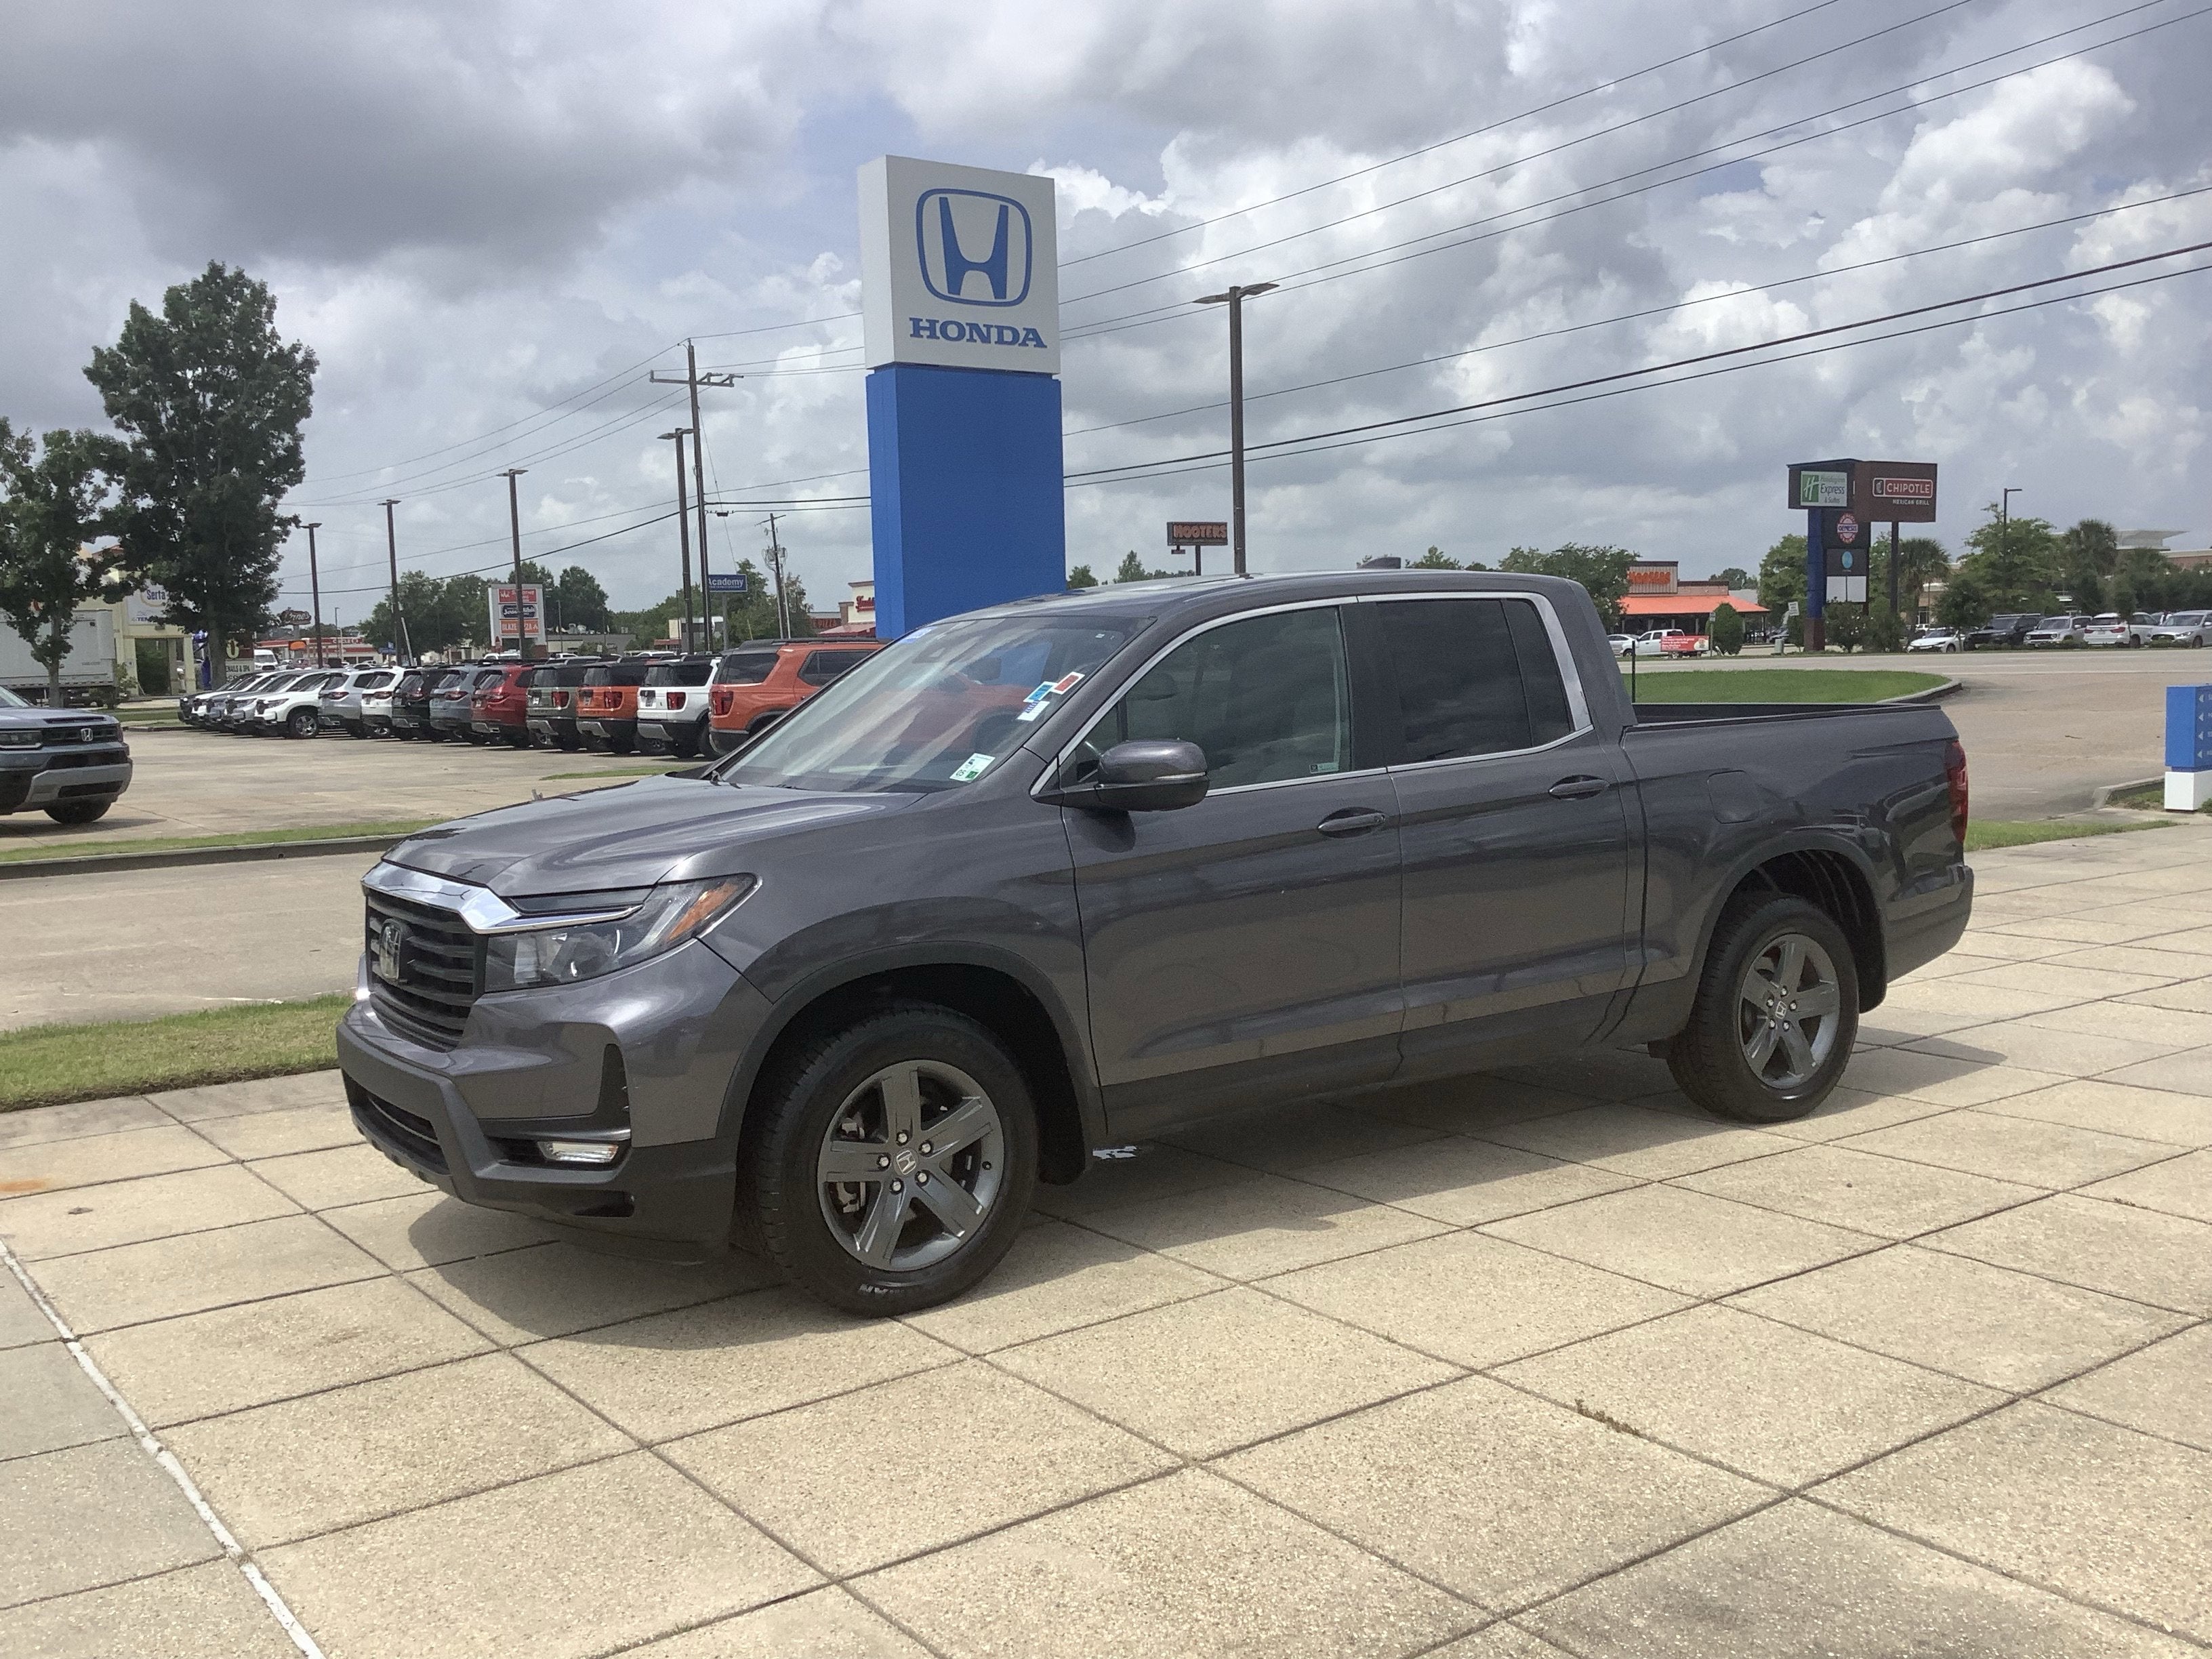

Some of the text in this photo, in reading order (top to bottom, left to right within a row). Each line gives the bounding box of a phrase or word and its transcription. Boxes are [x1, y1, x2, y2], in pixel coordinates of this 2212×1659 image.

[909, 317, 1047, 348] HONDA
[1820, 483, 1845, 496] Express
[1886, 483, 1930, 493] CHIPOTLE
[1173, 525, 1226, 538] HOOTERS
[146, 589, 166, 600] Serta
